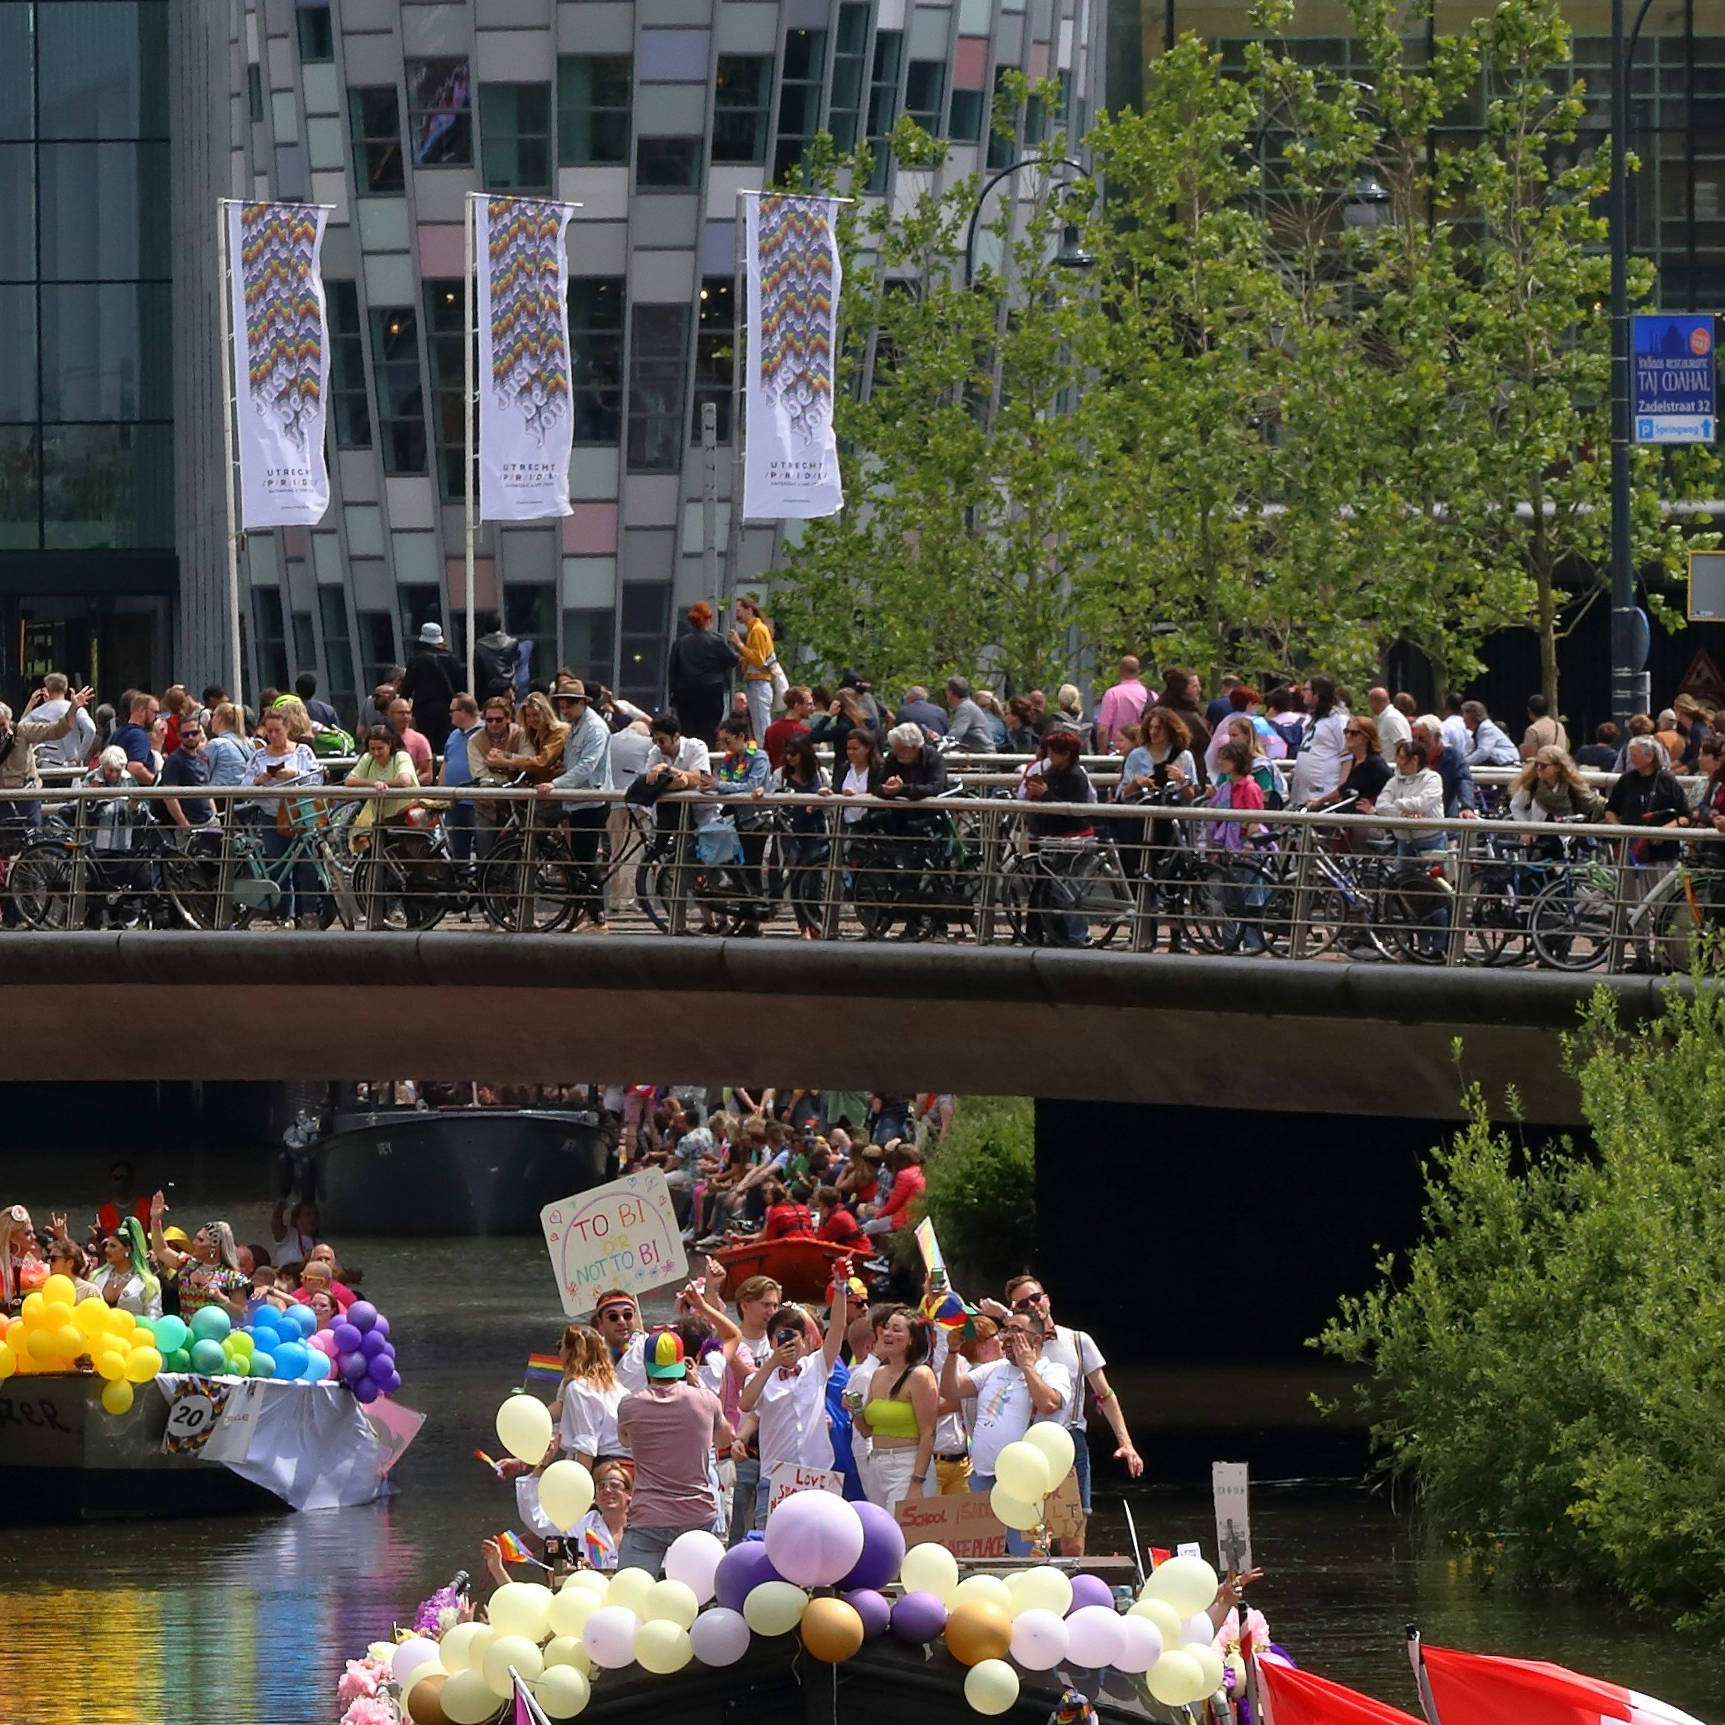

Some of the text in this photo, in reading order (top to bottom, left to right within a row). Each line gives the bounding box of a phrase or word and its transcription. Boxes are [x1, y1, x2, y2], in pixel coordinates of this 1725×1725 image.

[1637, 370, 1658, 395] TAJ
[1638, 400, 1711, 413] Zadelstraat 32
[1655, 424, 1699, 436] Springweg
[502, 463, 556, 472] UTRECHT
[770, 461, 824, 469] UTRECHT
[573, 1199, 646, 1242] TO BI
[601, 1233, 631, 1256] OR
[575, 1239, 661, 1286] NOT TO BI
[172, 1405, 205, 1427] 20
[795, 1468, 827, 1489] LOVE
